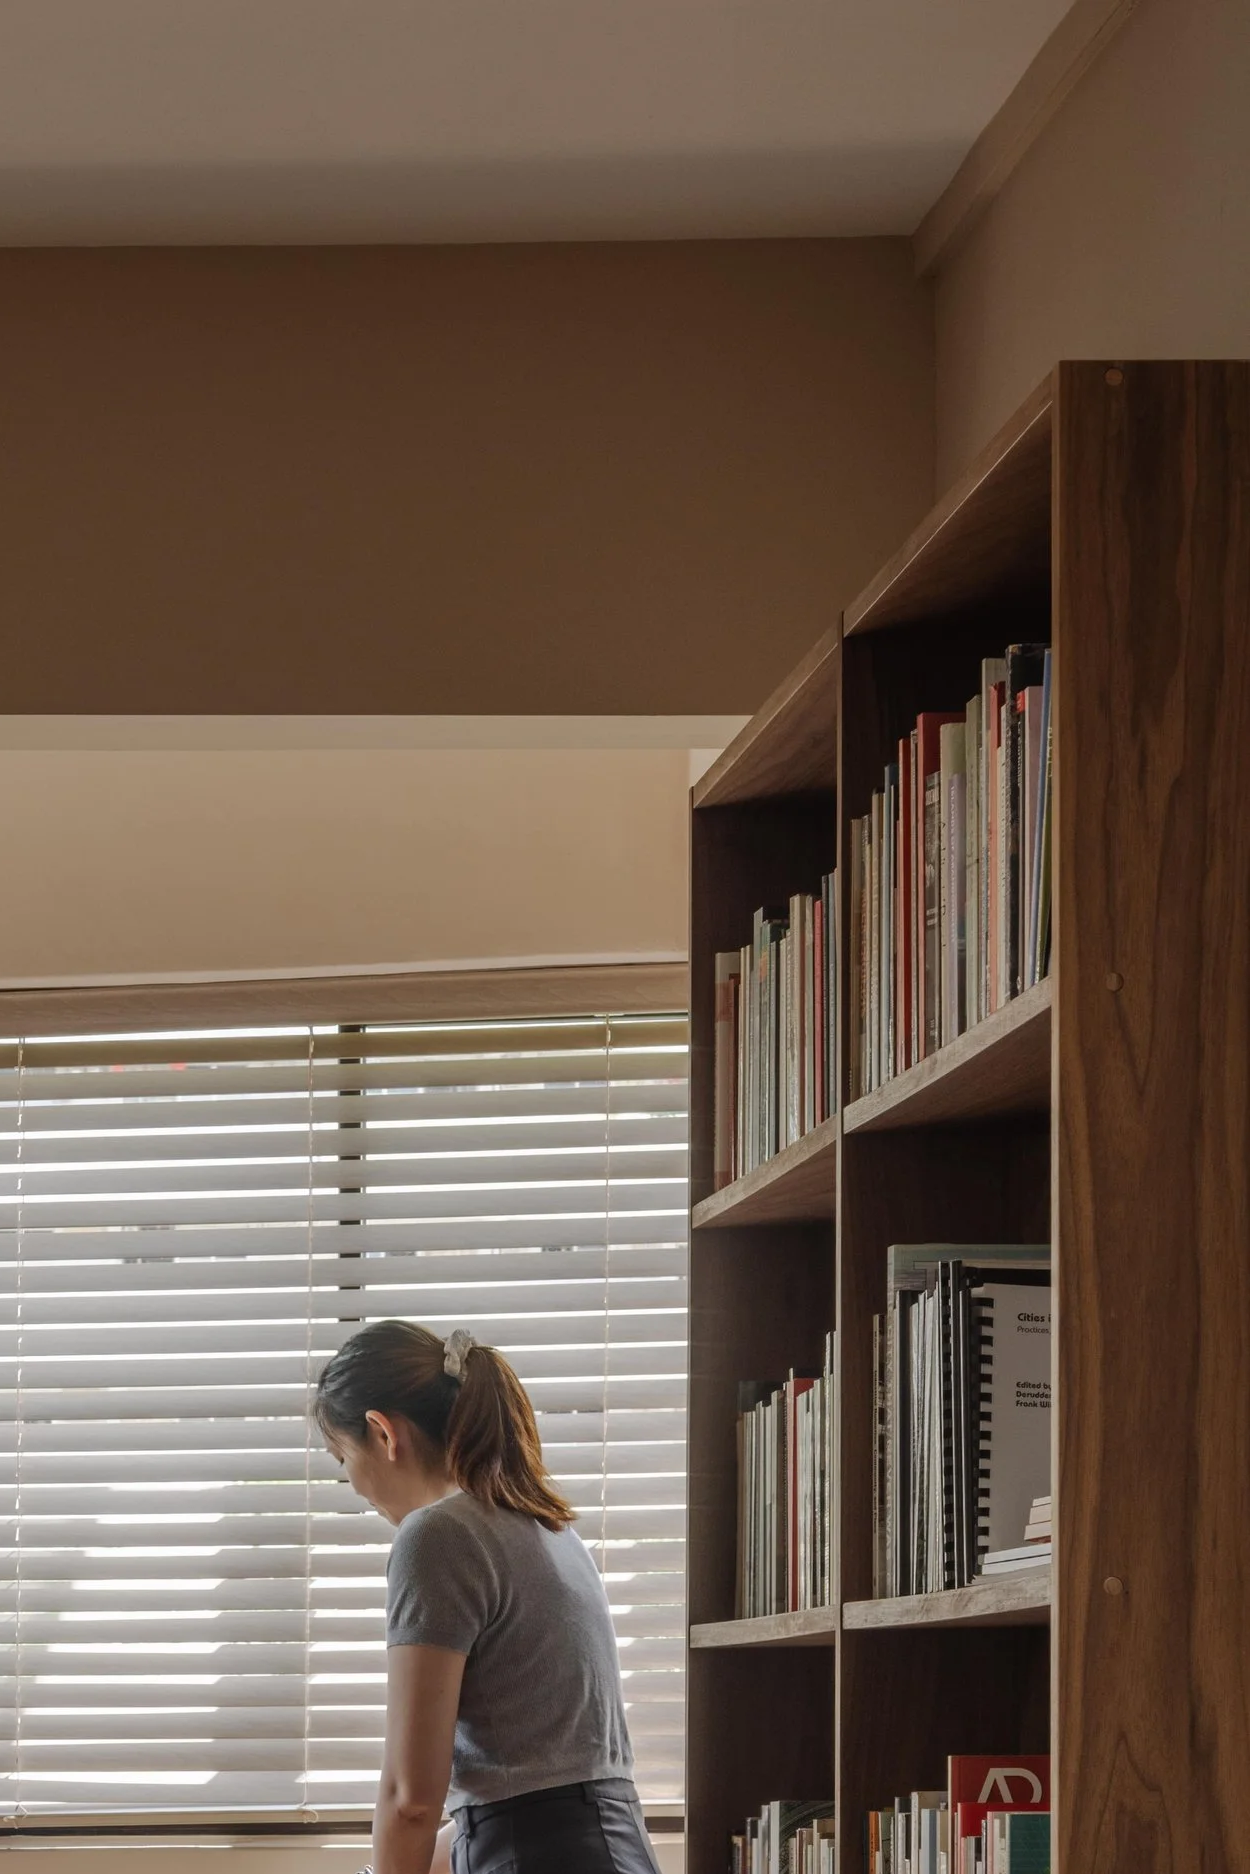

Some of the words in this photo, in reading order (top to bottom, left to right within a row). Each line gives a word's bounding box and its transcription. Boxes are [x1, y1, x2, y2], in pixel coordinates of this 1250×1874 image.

[1017, 1312, 1045, 1322] Cities
[1016, 1381, 1041, 1389] Edited
[1016, 1400, 1038, 1408] Frank
[977, 1767, 1042, 1803] AD
